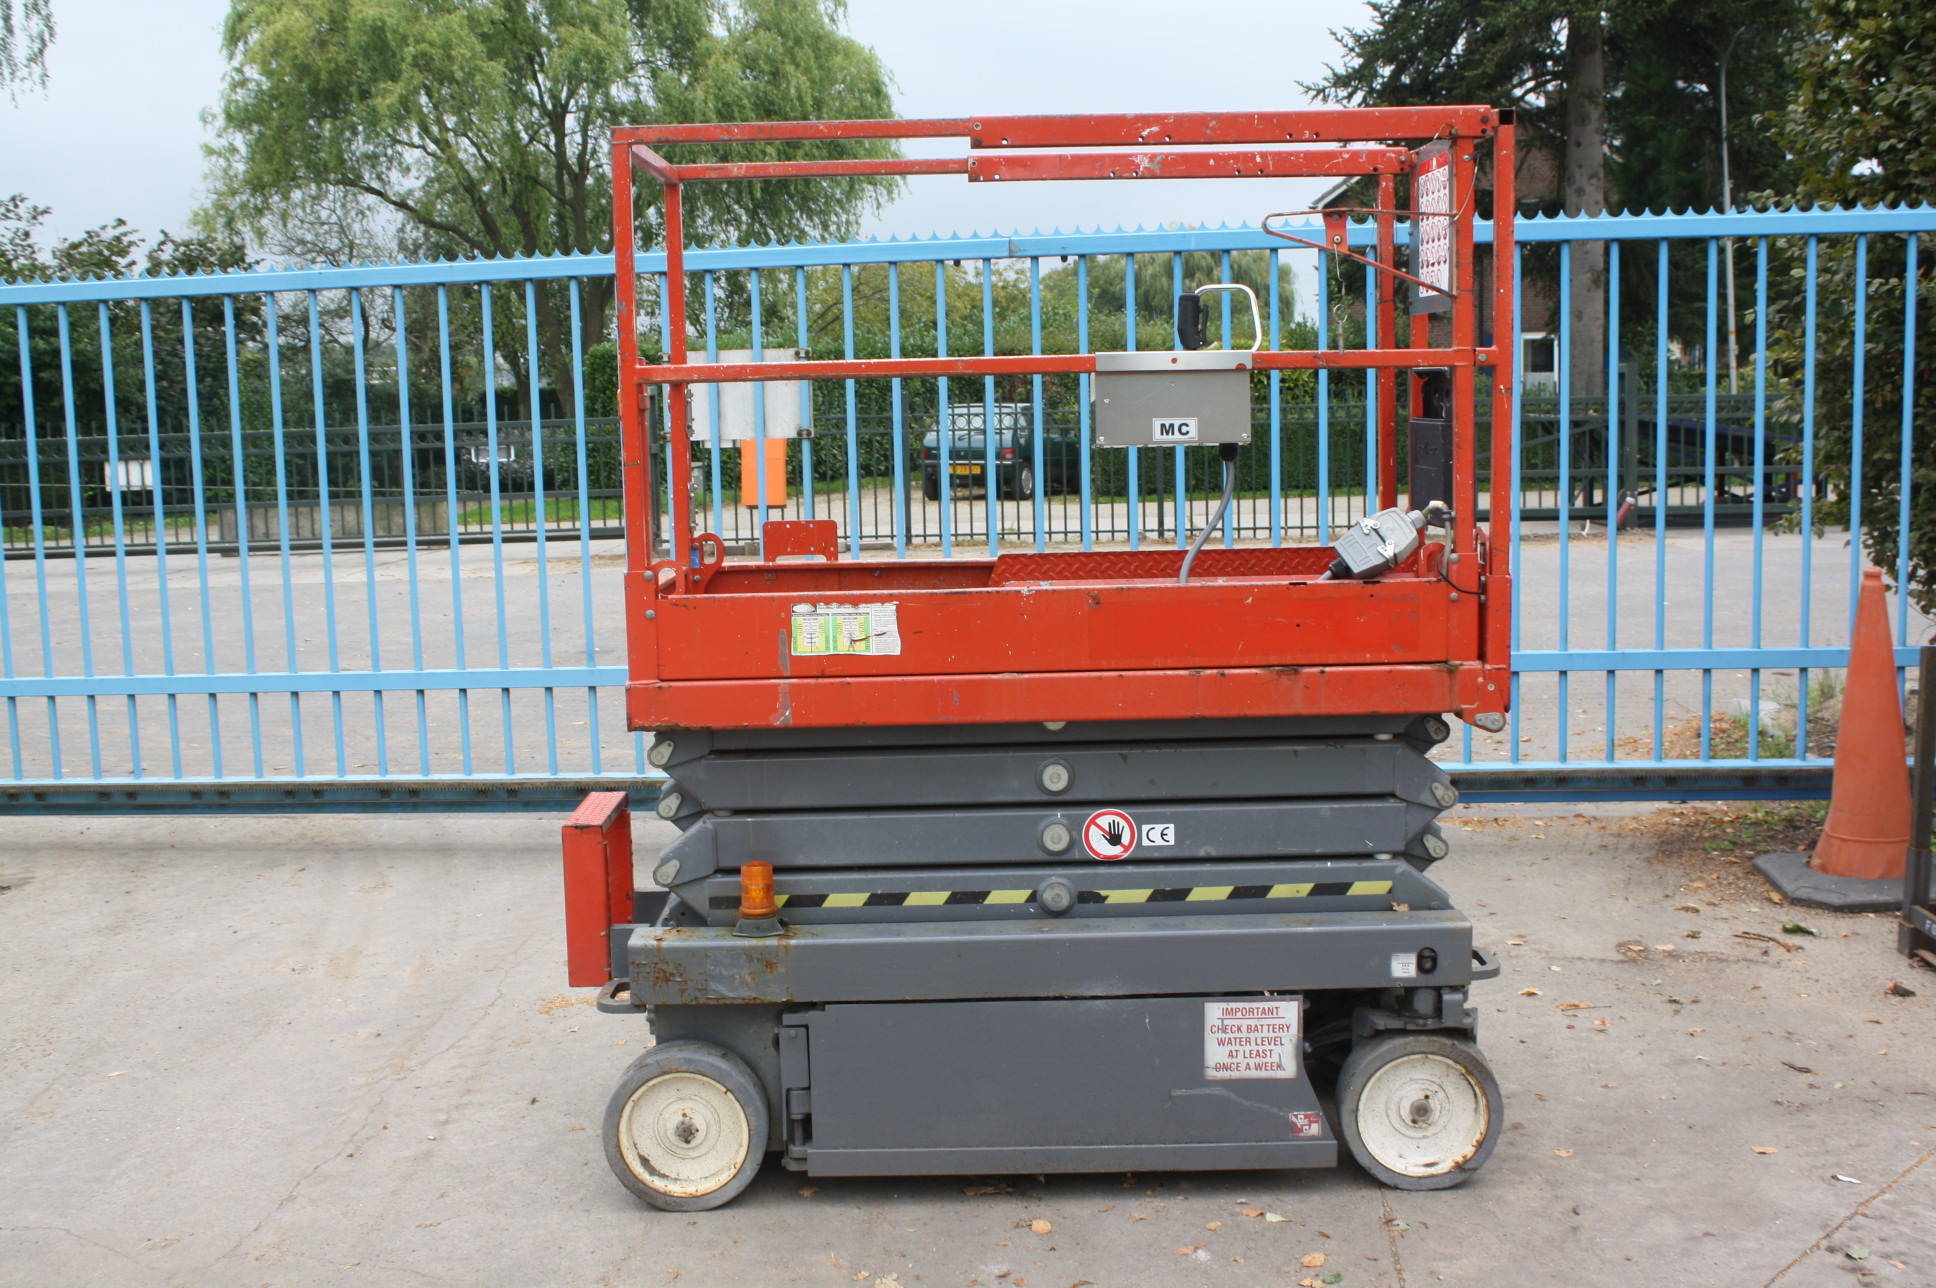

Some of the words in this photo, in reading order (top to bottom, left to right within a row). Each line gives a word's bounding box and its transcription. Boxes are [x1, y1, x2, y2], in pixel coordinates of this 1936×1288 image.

[1160, 423, 1190, 436] MC
[1221, 1006, 1280, 1017] IMPORTANT
[1210, 1024, 1243, 1035] CHECK
[1246, 1023, 1292, 1034] BATTERY
[1216, 1036, 1252, 1047] WATER
[1255, 1036, 1285, 1046] LEVEL
[1227, 1049, 1240, 1060] AT
[1243, 1049, 1275, 1059] LEAST
[1215, 1062, 1242, 1072] ONCE
[1244, 1062, 1251, 1071] A
